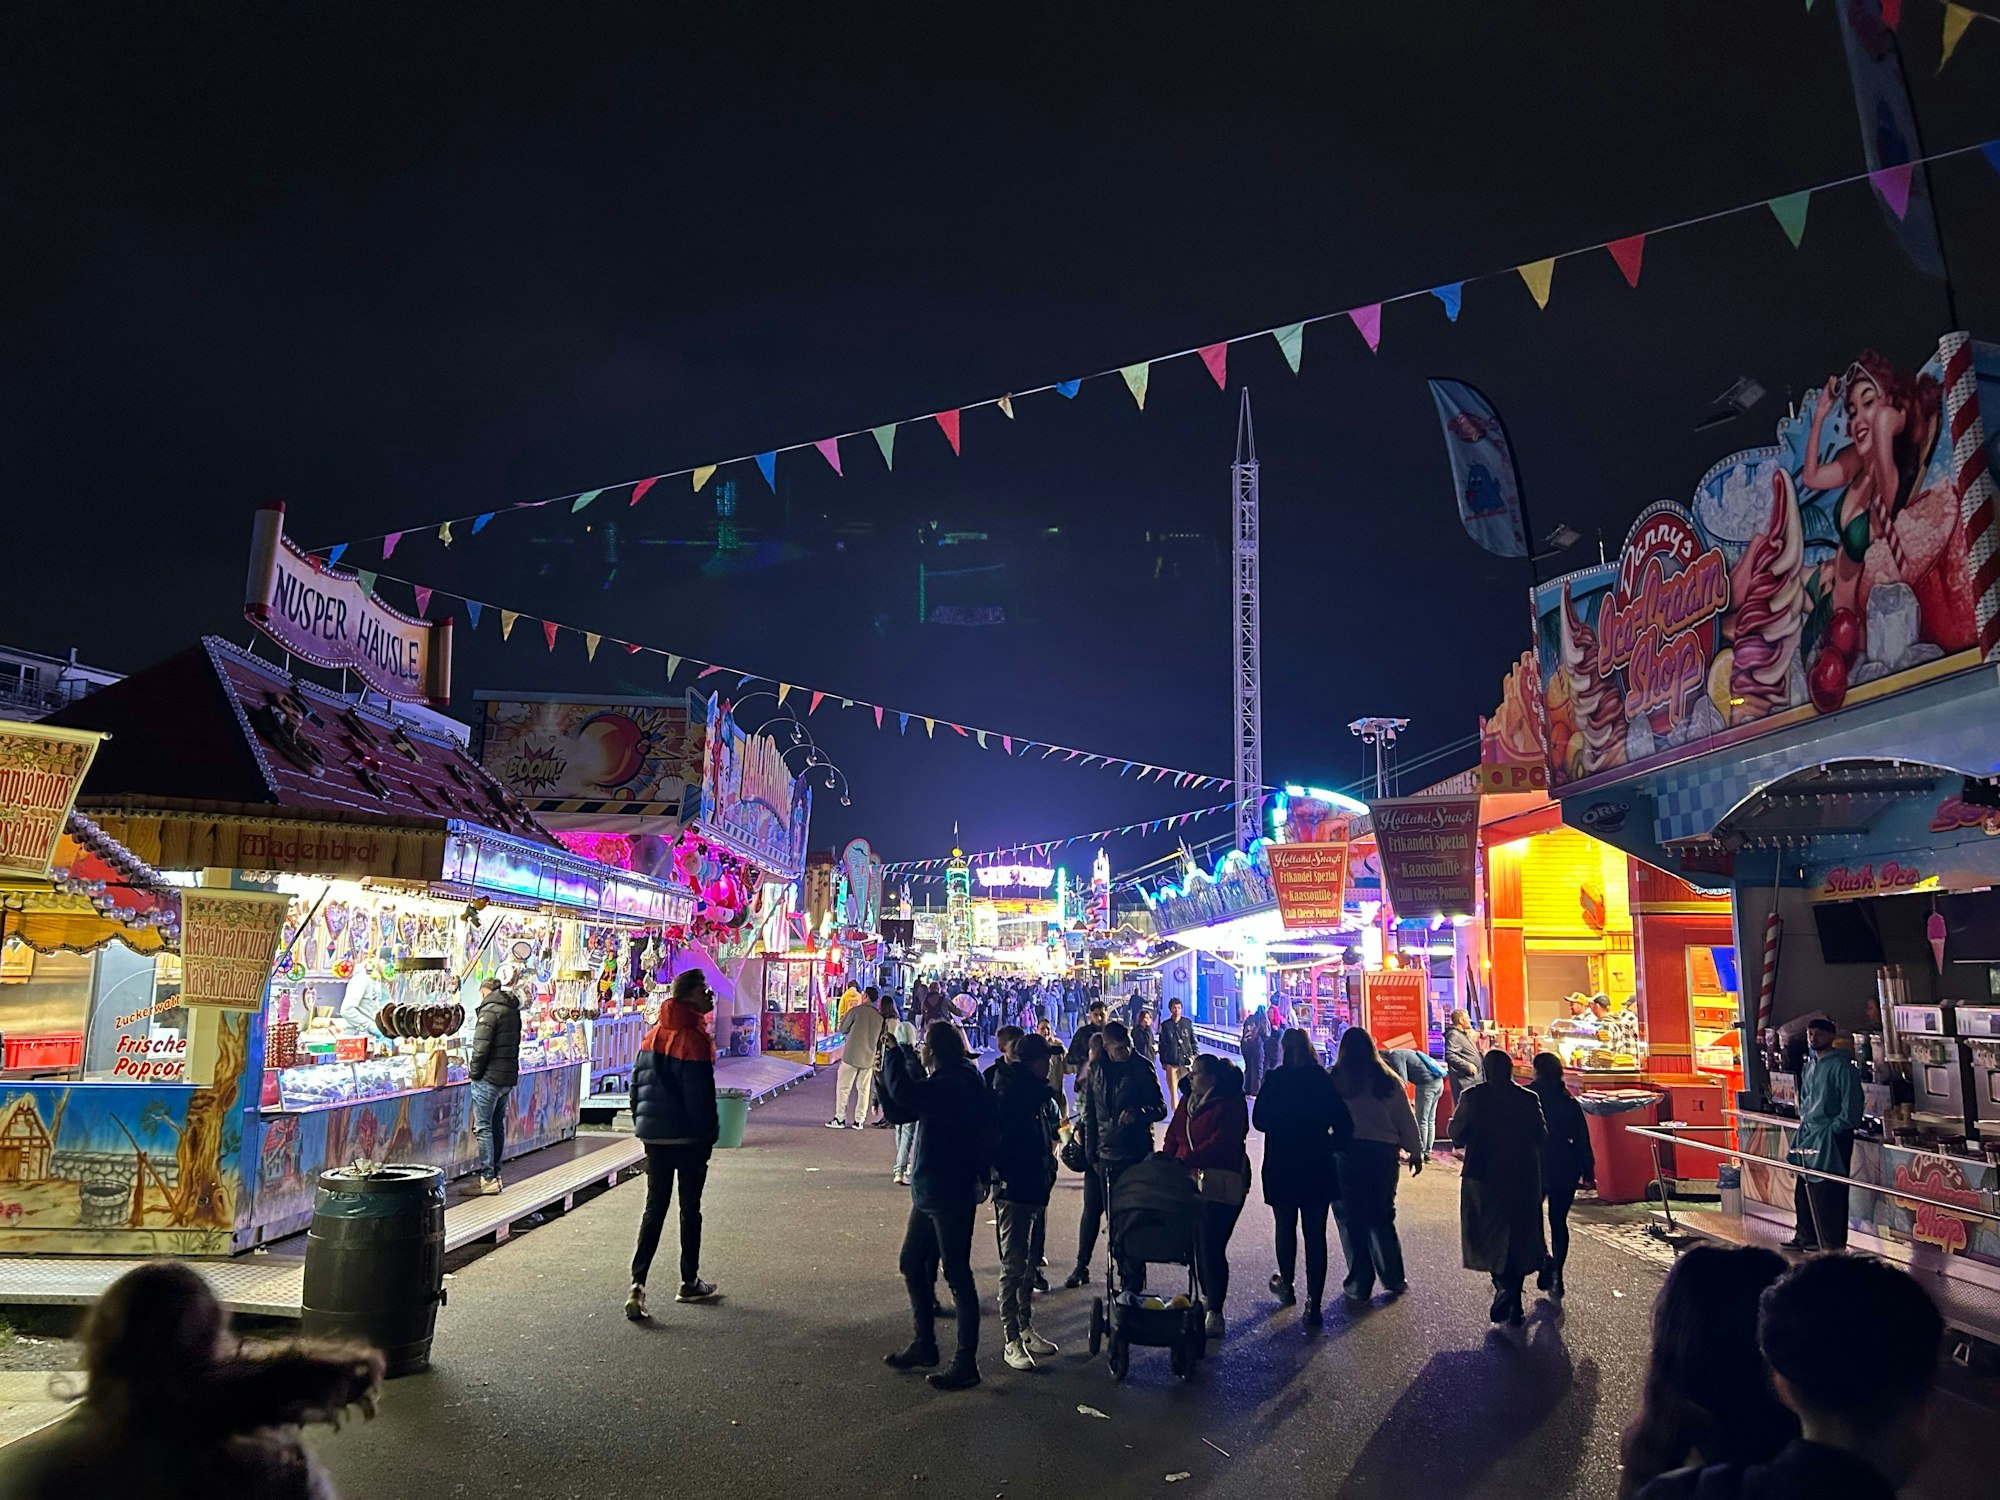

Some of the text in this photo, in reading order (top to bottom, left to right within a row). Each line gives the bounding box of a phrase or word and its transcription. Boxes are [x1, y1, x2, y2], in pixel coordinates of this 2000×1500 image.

[1620, 522, 1695, 601] Danny's
[356, 610, 420, 680] HÄUSLE
[1626, 633, 1701, 720] Shop
[506, 757, 567, 781] BOOM!
[1380, 806, 1473, 831] Holland Snack
[1581, 803, 1629, 824] OREO
[0, 816, 55, 860] schlik
[240, 834, 379, 864] Magenbrot
[1388, 833, 1469, 852] Frikandel Spezial
[1274, 850, 1342, 868] Holland Snack
[1280, 870, 1338, 883] Frikandel Spezial
[1825, 861, 1919, 893] Slush Ice
[1414, 887, 1438, 901] Cheese
[1439, 886, 1470, 900] Pommes
[185, 920, 277, 961] Käsebratwurst
[185, 960, 265, 1000] Käsekrakauer
[116, 1034, 187, 1053] Frische
[1915, 1203, 1965, 1253] Shop
